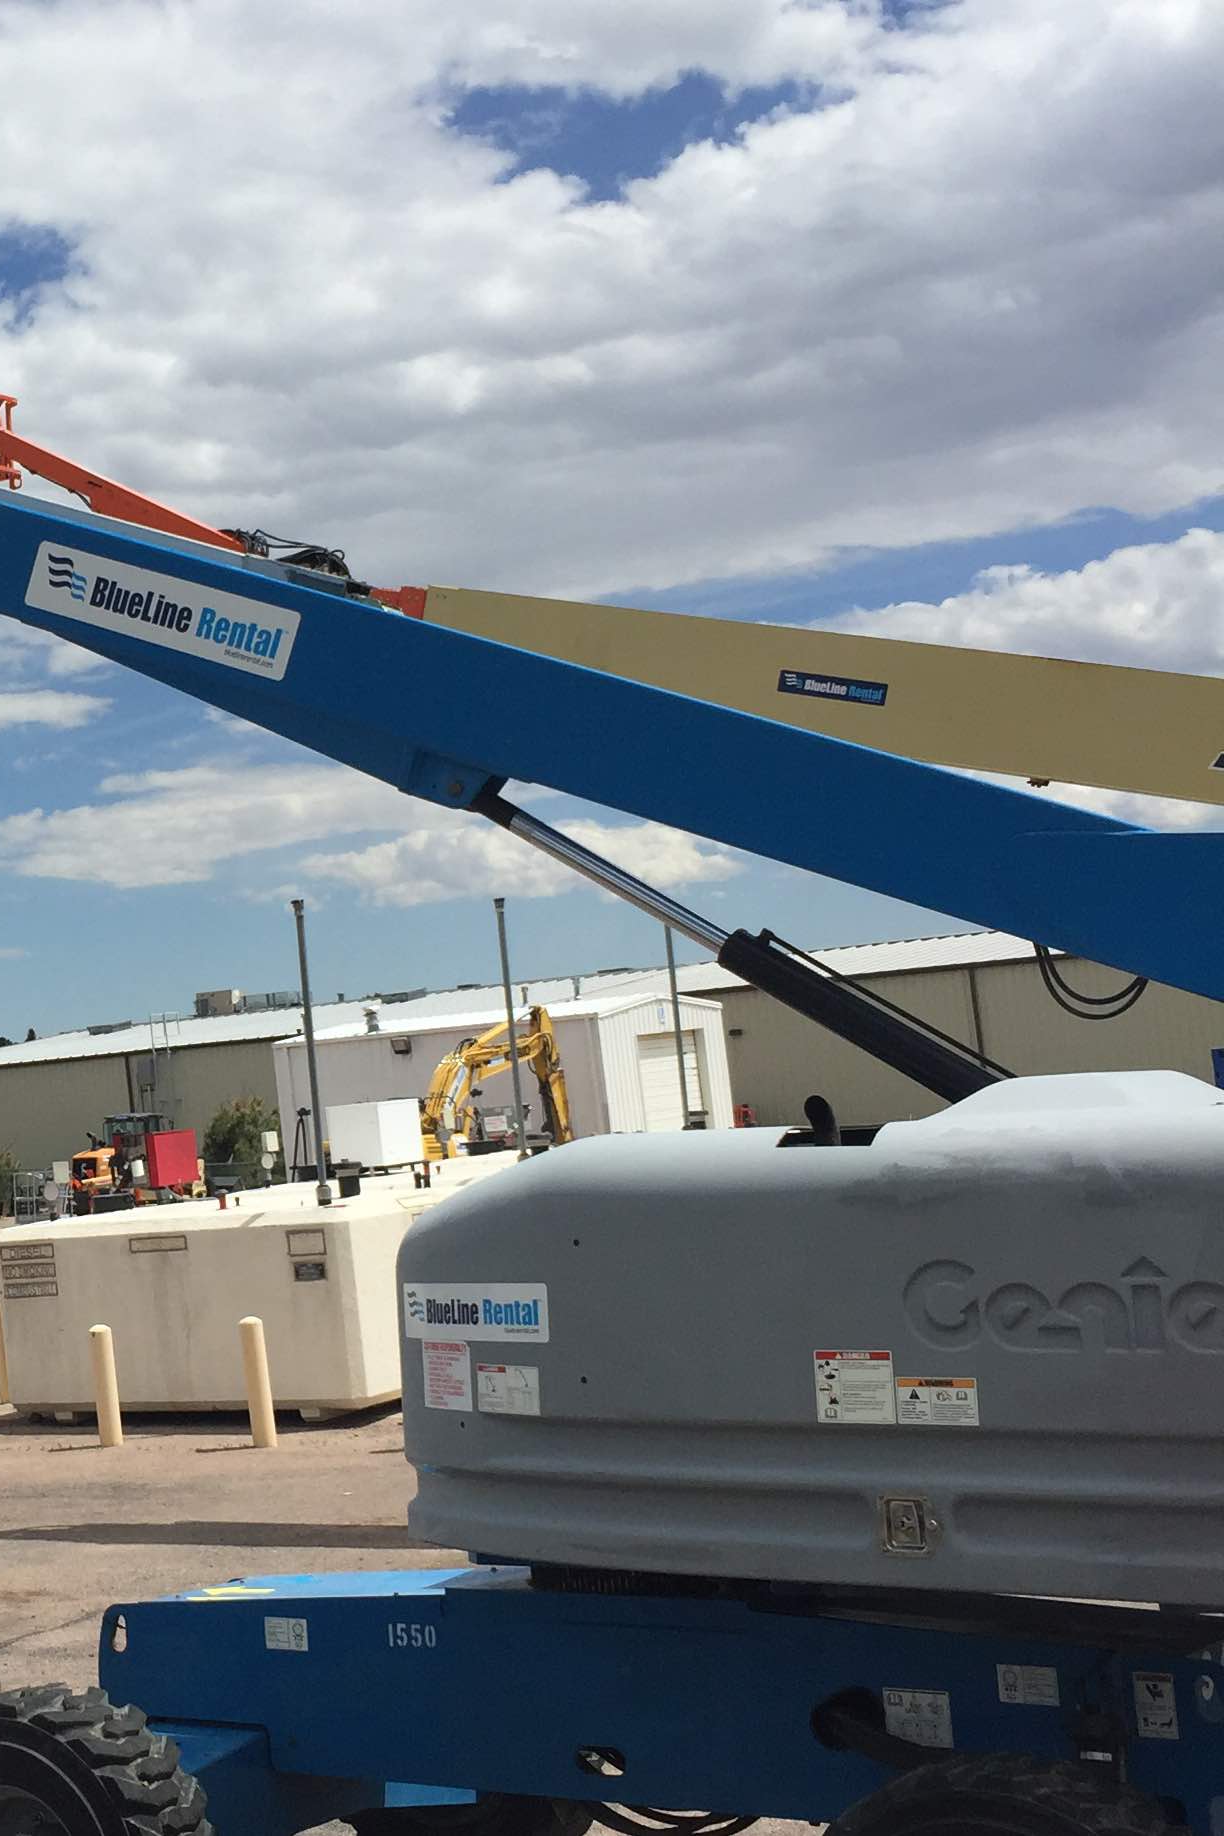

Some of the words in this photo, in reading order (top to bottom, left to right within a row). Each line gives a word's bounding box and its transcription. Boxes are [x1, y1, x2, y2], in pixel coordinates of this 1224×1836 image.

[89, 576, 193, 633] BlueLine
[195, 607, 283, 659] Rental
[804, 679, 848, 696] BlueLine
[848, 685, 885, 701] Rental
[426, 1298, 480, 1326] BlueLine
[482, 1298, 540, 1327] Rental
[387, 1623, 436, 1648] 1550
